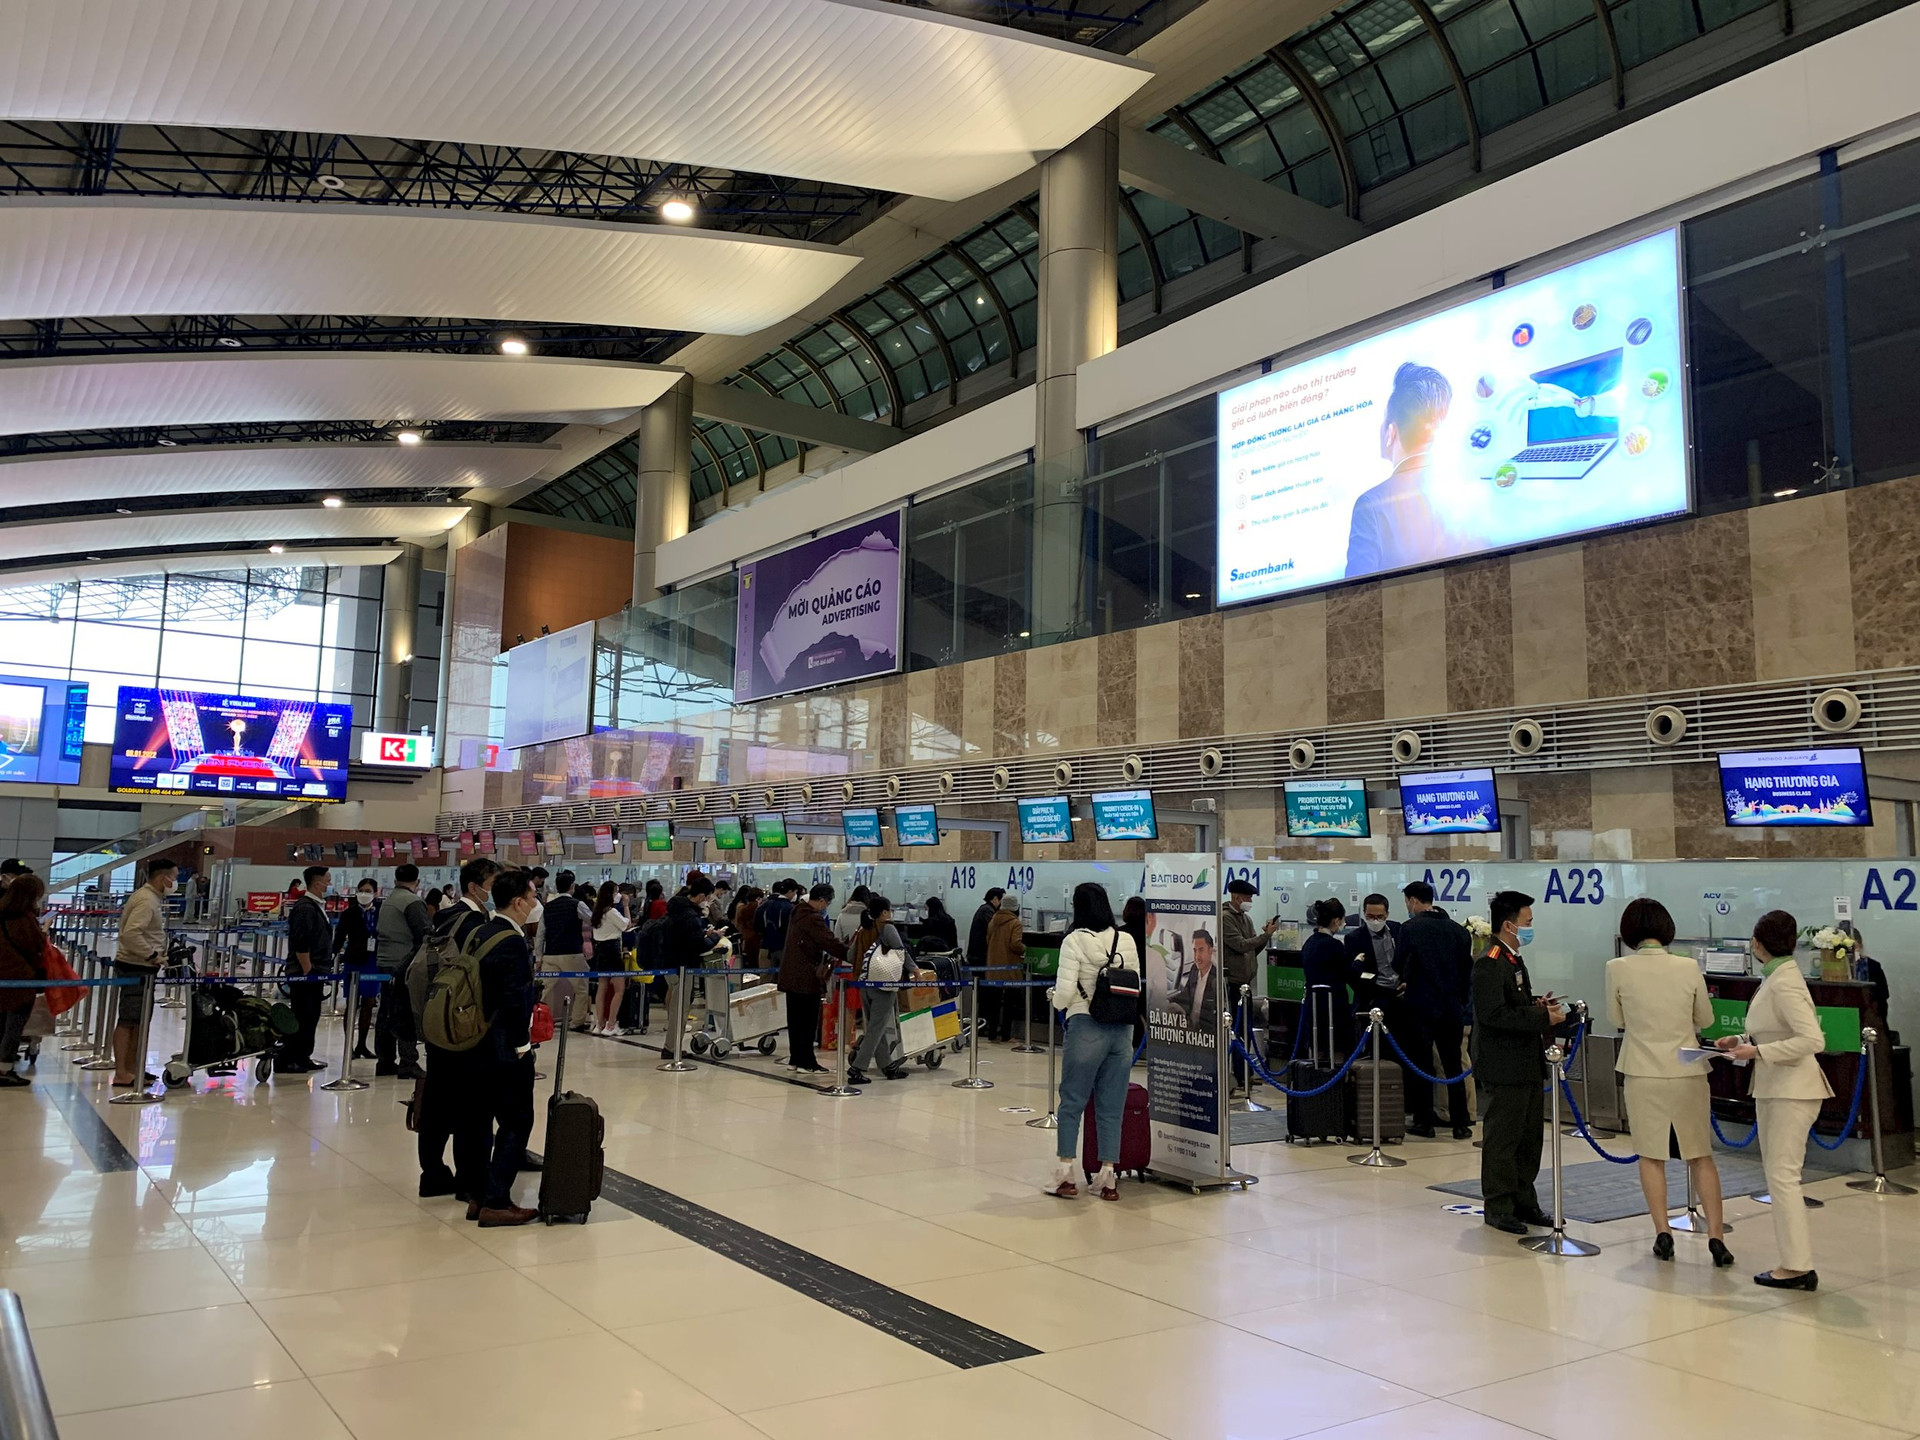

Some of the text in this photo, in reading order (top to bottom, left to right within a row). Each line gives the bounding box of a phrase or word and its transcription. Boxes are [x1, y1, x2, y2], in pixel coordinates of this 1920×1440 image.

[1249, 396, 1271, 410] pháp
[1273, 389, 1290, 401] nào
[1292, 382, 1308, 394] cho
[1310, 376, 1322, 388] thị
[1325, 366, 1356, 382] trường
[1294, 421, 1306, 430] LAI
[1230, 558, 1294, 582] Sacombank
[788, 578, 882, 619] MỜI QUẢNG CÁO
[822, 600, 880, 626] ADVERTISING
[384, 740, 412, 757] K+
[1744, 774, 1840, 791] HẠNG THƯƠNG GIA
[1417, 790, 1479, 805] HẠNG THƯƠNG GIA
[812, 866, 831, 885] A16
[854, 866, 874, 886] A17
[951, 866, 976, 889] A18
[1007, 866, 1034, 890] A19
[1151, 874, 1194, 884] BAMBOO
[1423, 869, 1471, 902] A22
[1544, 868, 1604, 904] A23
[1859, 868, 1918, 910] A2
[1181, 904, 1212, 912] BUSINESS
[1150, 1008, 1188, 1028] ĐÃ BAY là
[1150, 1026, 1215, 1048] THƯỢNG KHÁCH
